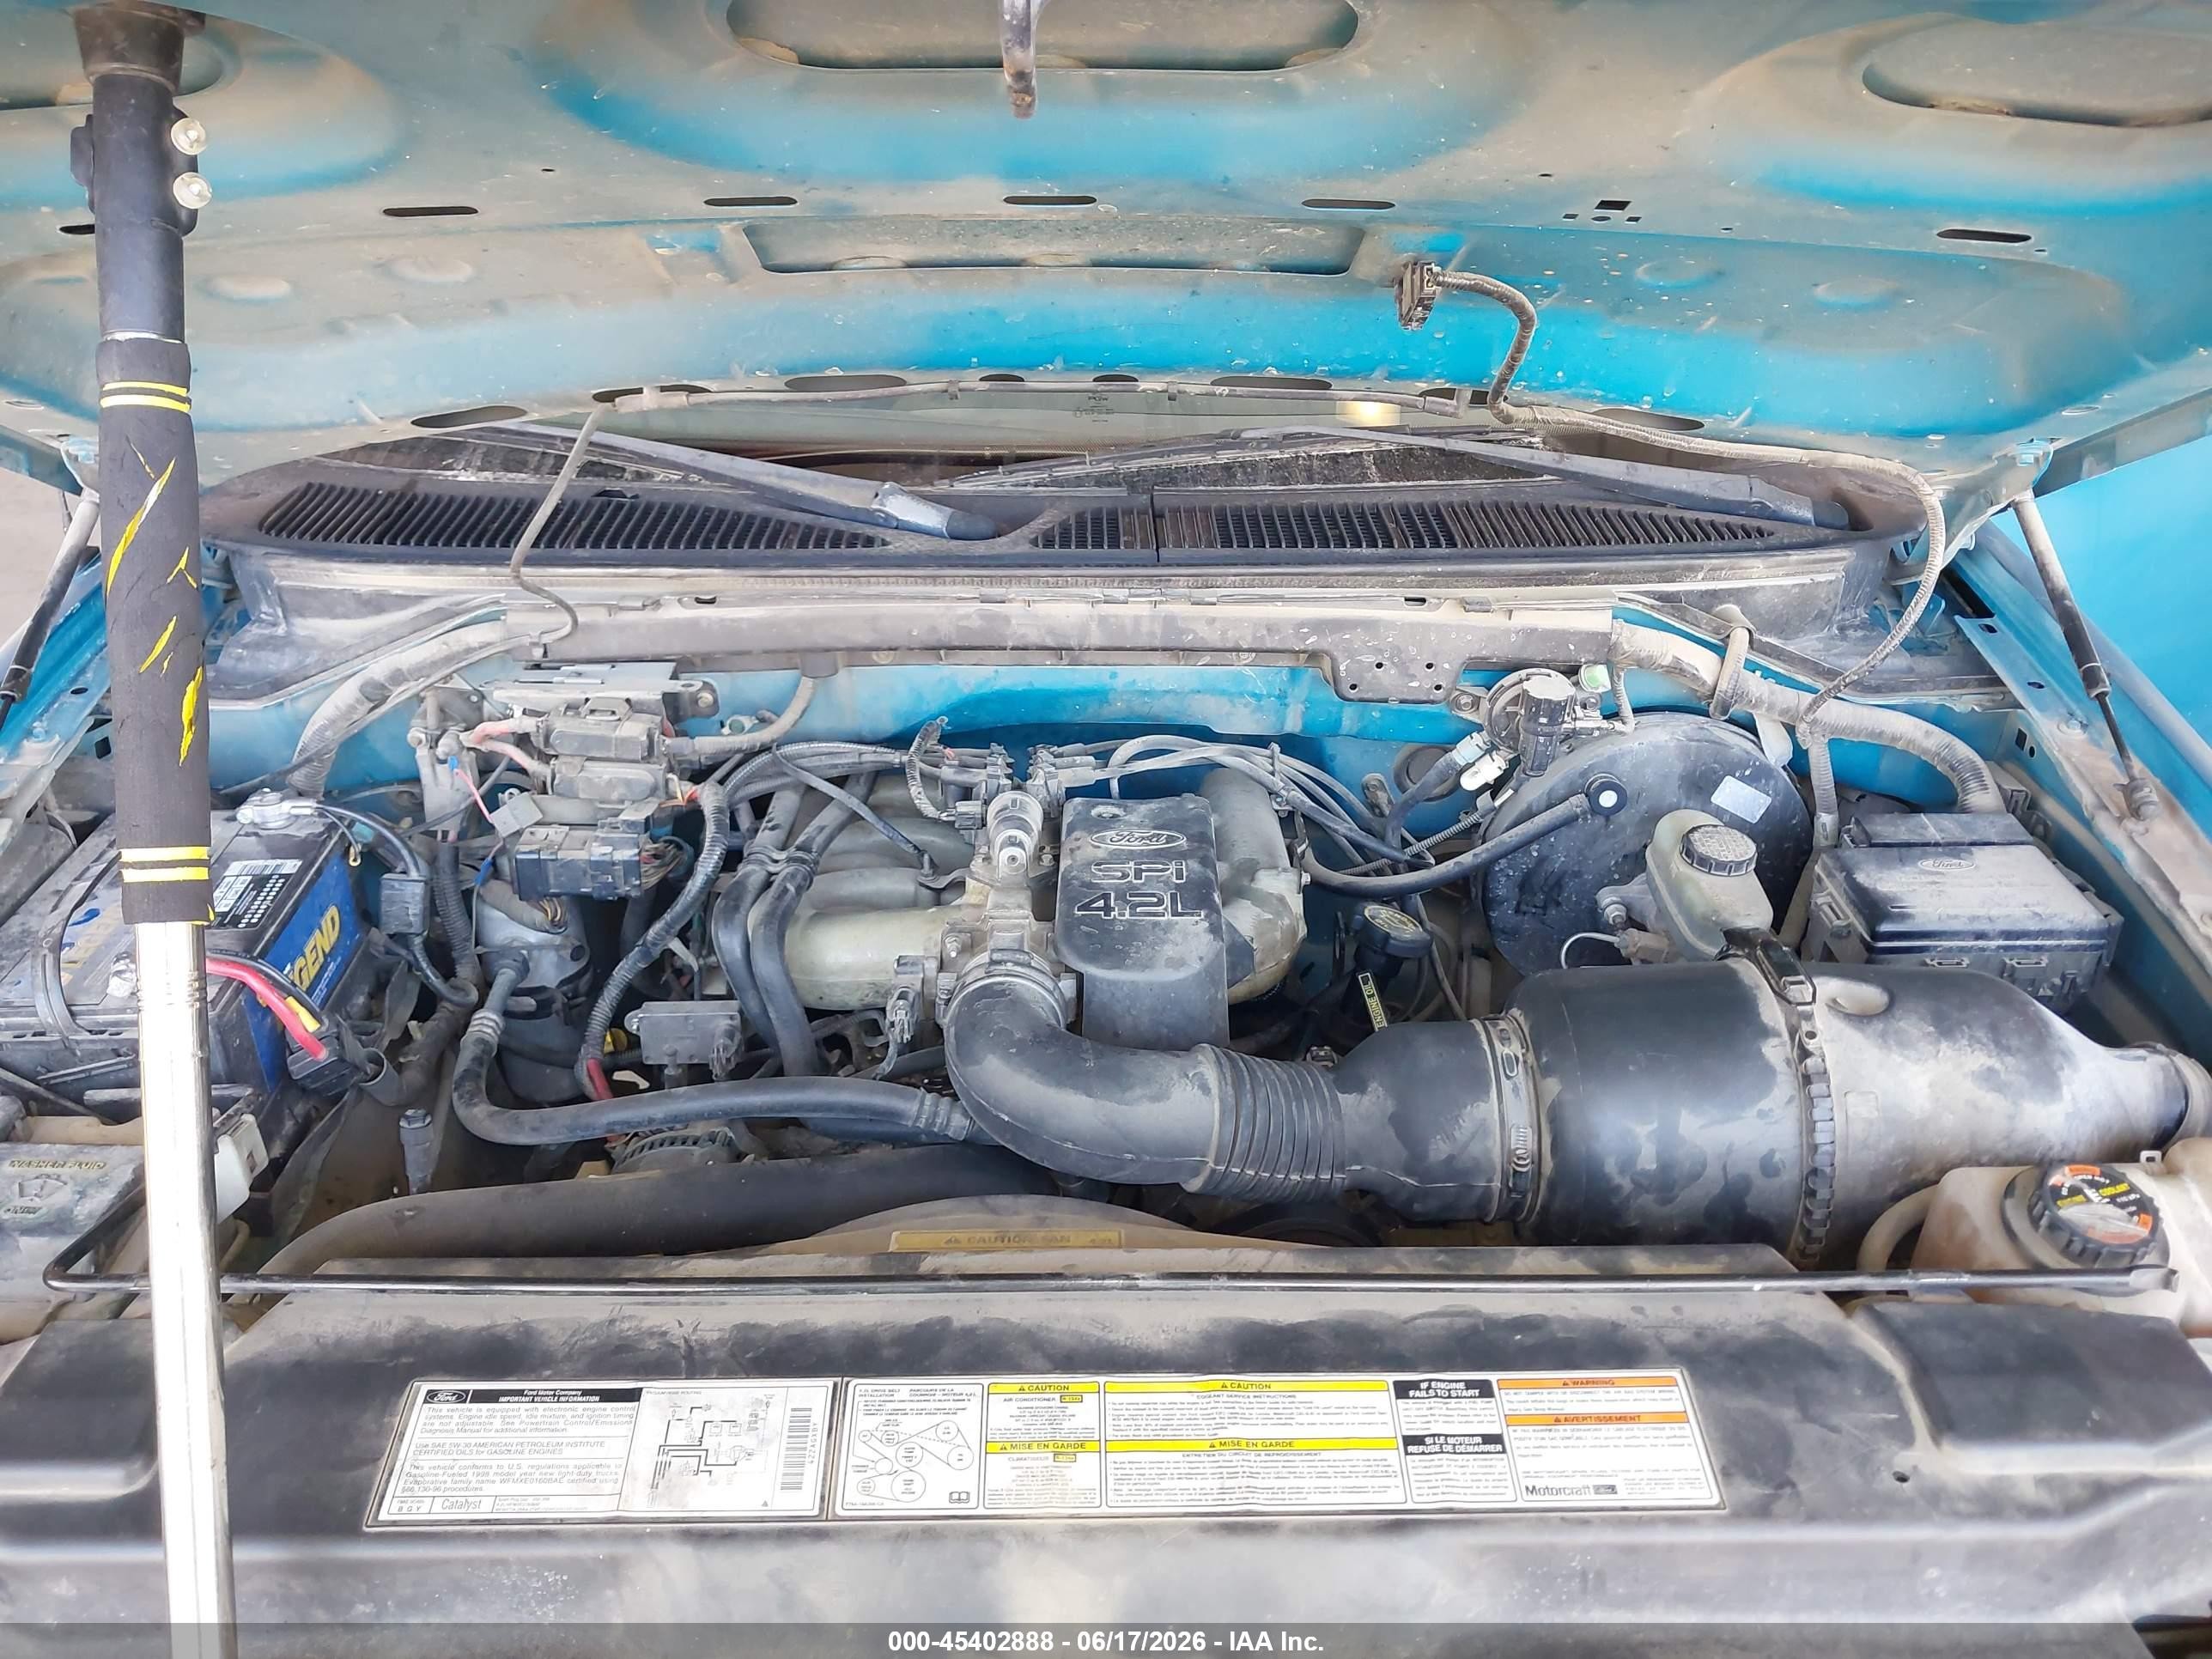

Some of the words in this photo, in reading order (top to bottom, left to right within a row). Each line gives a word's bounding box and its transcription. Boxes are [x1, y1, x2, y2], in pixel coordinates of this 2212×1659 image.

[1109, 830, 1166, 845] Ford
[1930, 860, 1965, 869] Ford
[1091, 860, 1186, 884] SPi
[1075, 891, 1204, 920] 4.2L
[1364, 980, 1374, 995] OIL
[1368, 996, 1385, 1029] ENGINE
[967, 1236, 1030, 1244] CAUTION
[1431, 1381, 1467, 1389] ENGINE
[433, 1391, 458, 1402] Ford
[1261, 1440, 1295, 1449] GARDE
[1434, 1436, 1446, 1444] LE
[1447, 1436, 1483, 1444] MOTEUR
[1407, 1444, 1442, 1454] REFUSE
[1442, 1444, 1455, 1453] DE
[1524, 1484, 1592, 1497] Motorcraft
[441, 1498, 482, 1511] Catalyst
